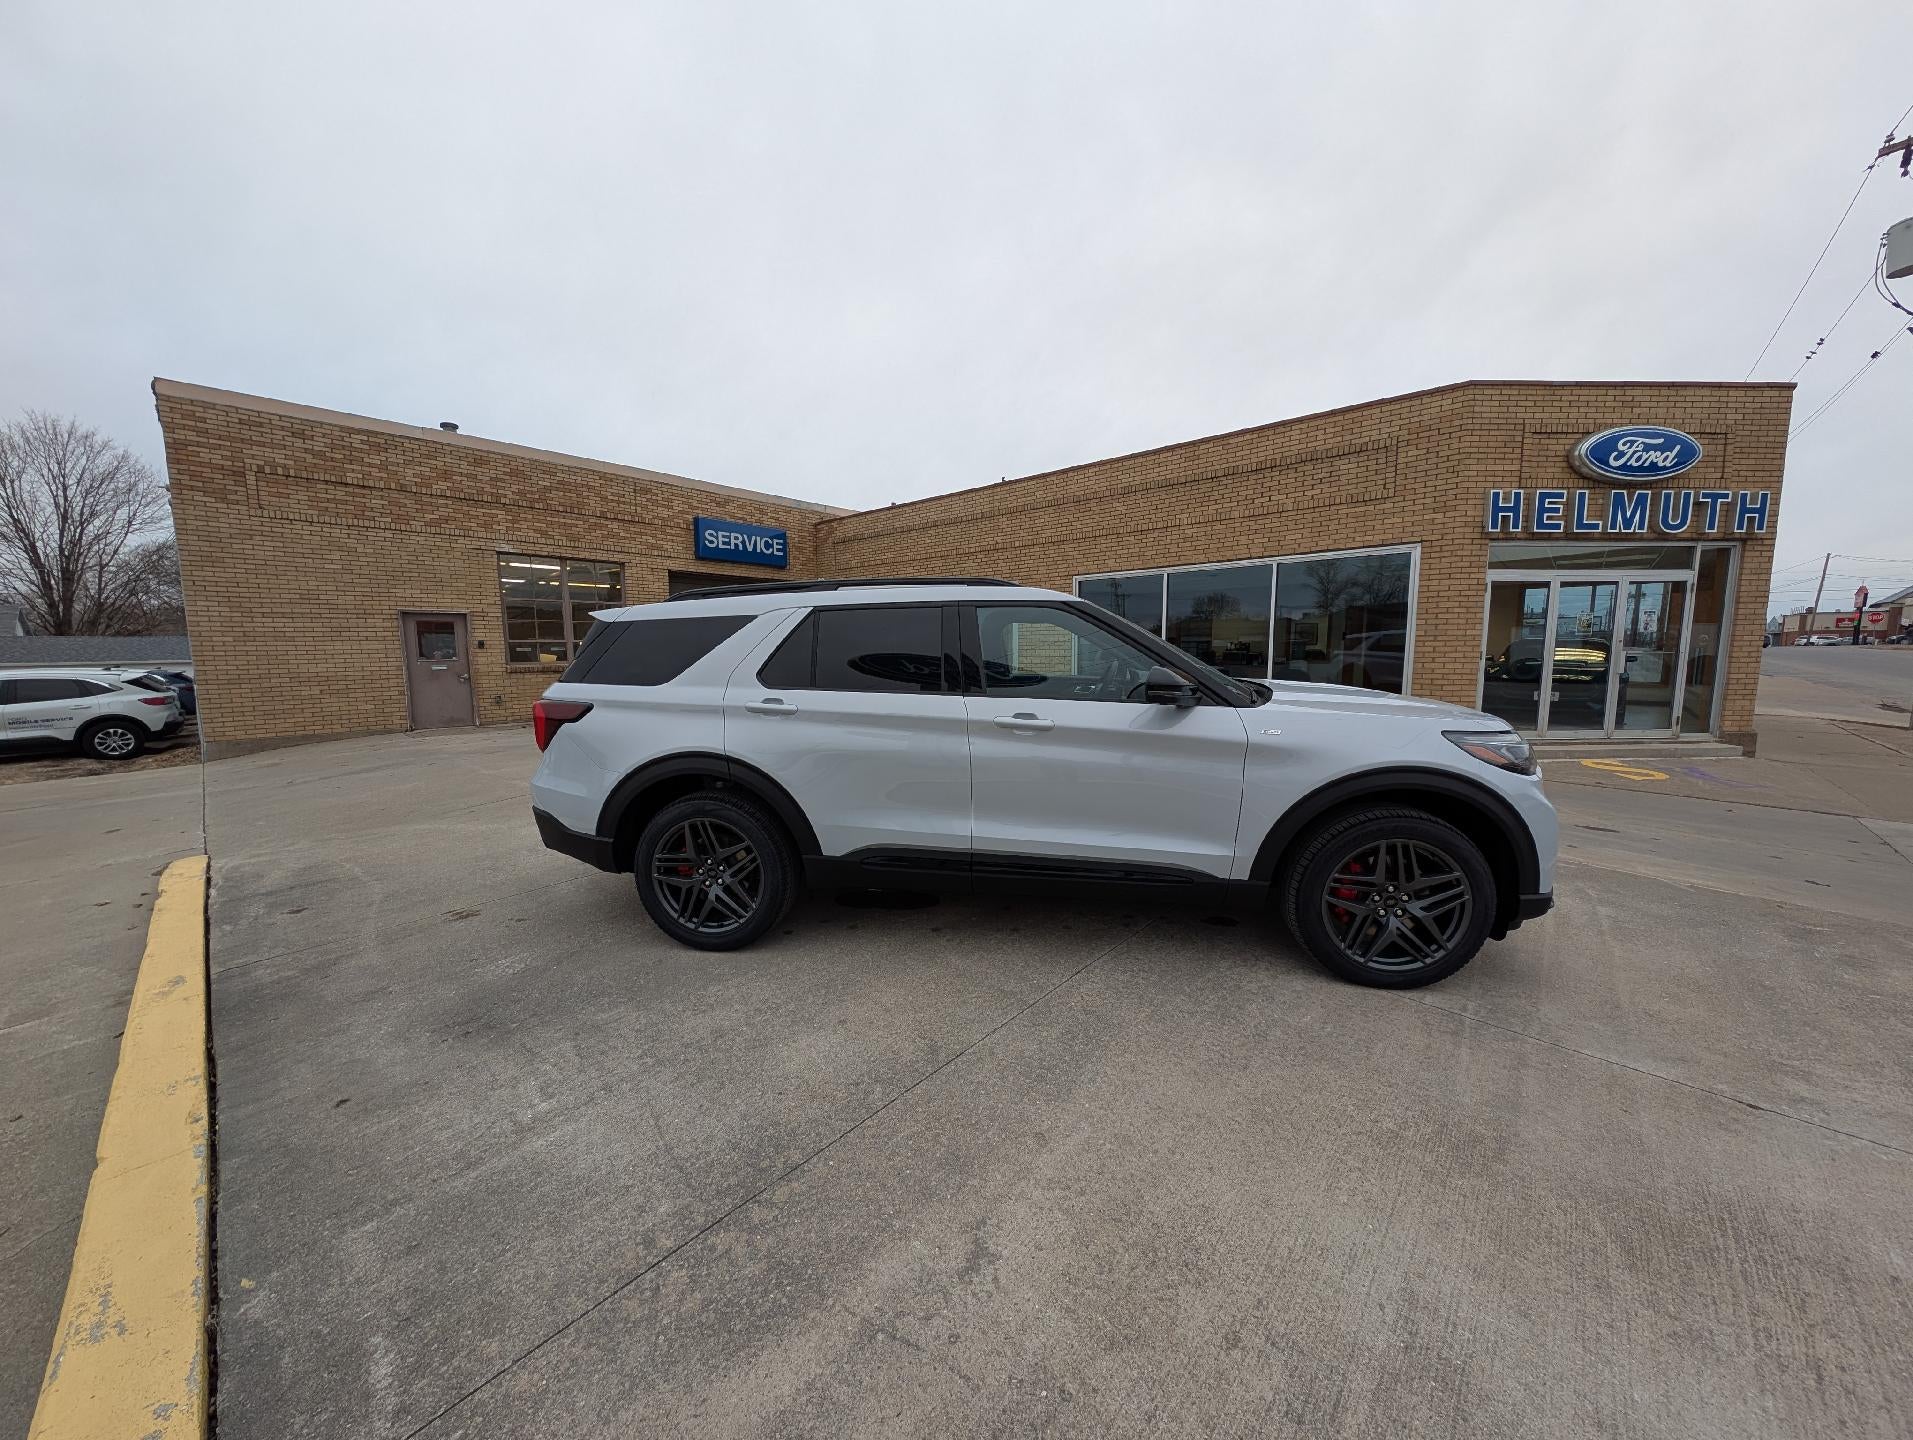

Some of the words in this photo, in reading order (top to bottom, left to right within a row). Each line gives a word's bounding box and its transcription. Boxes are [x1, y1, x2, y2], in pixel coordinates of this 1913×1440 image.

[1608, 436, 1681, 468] Ford
[1487, 488, 1771, 533] HELMUTH
[704, 529, 784, 556] SERVICE
